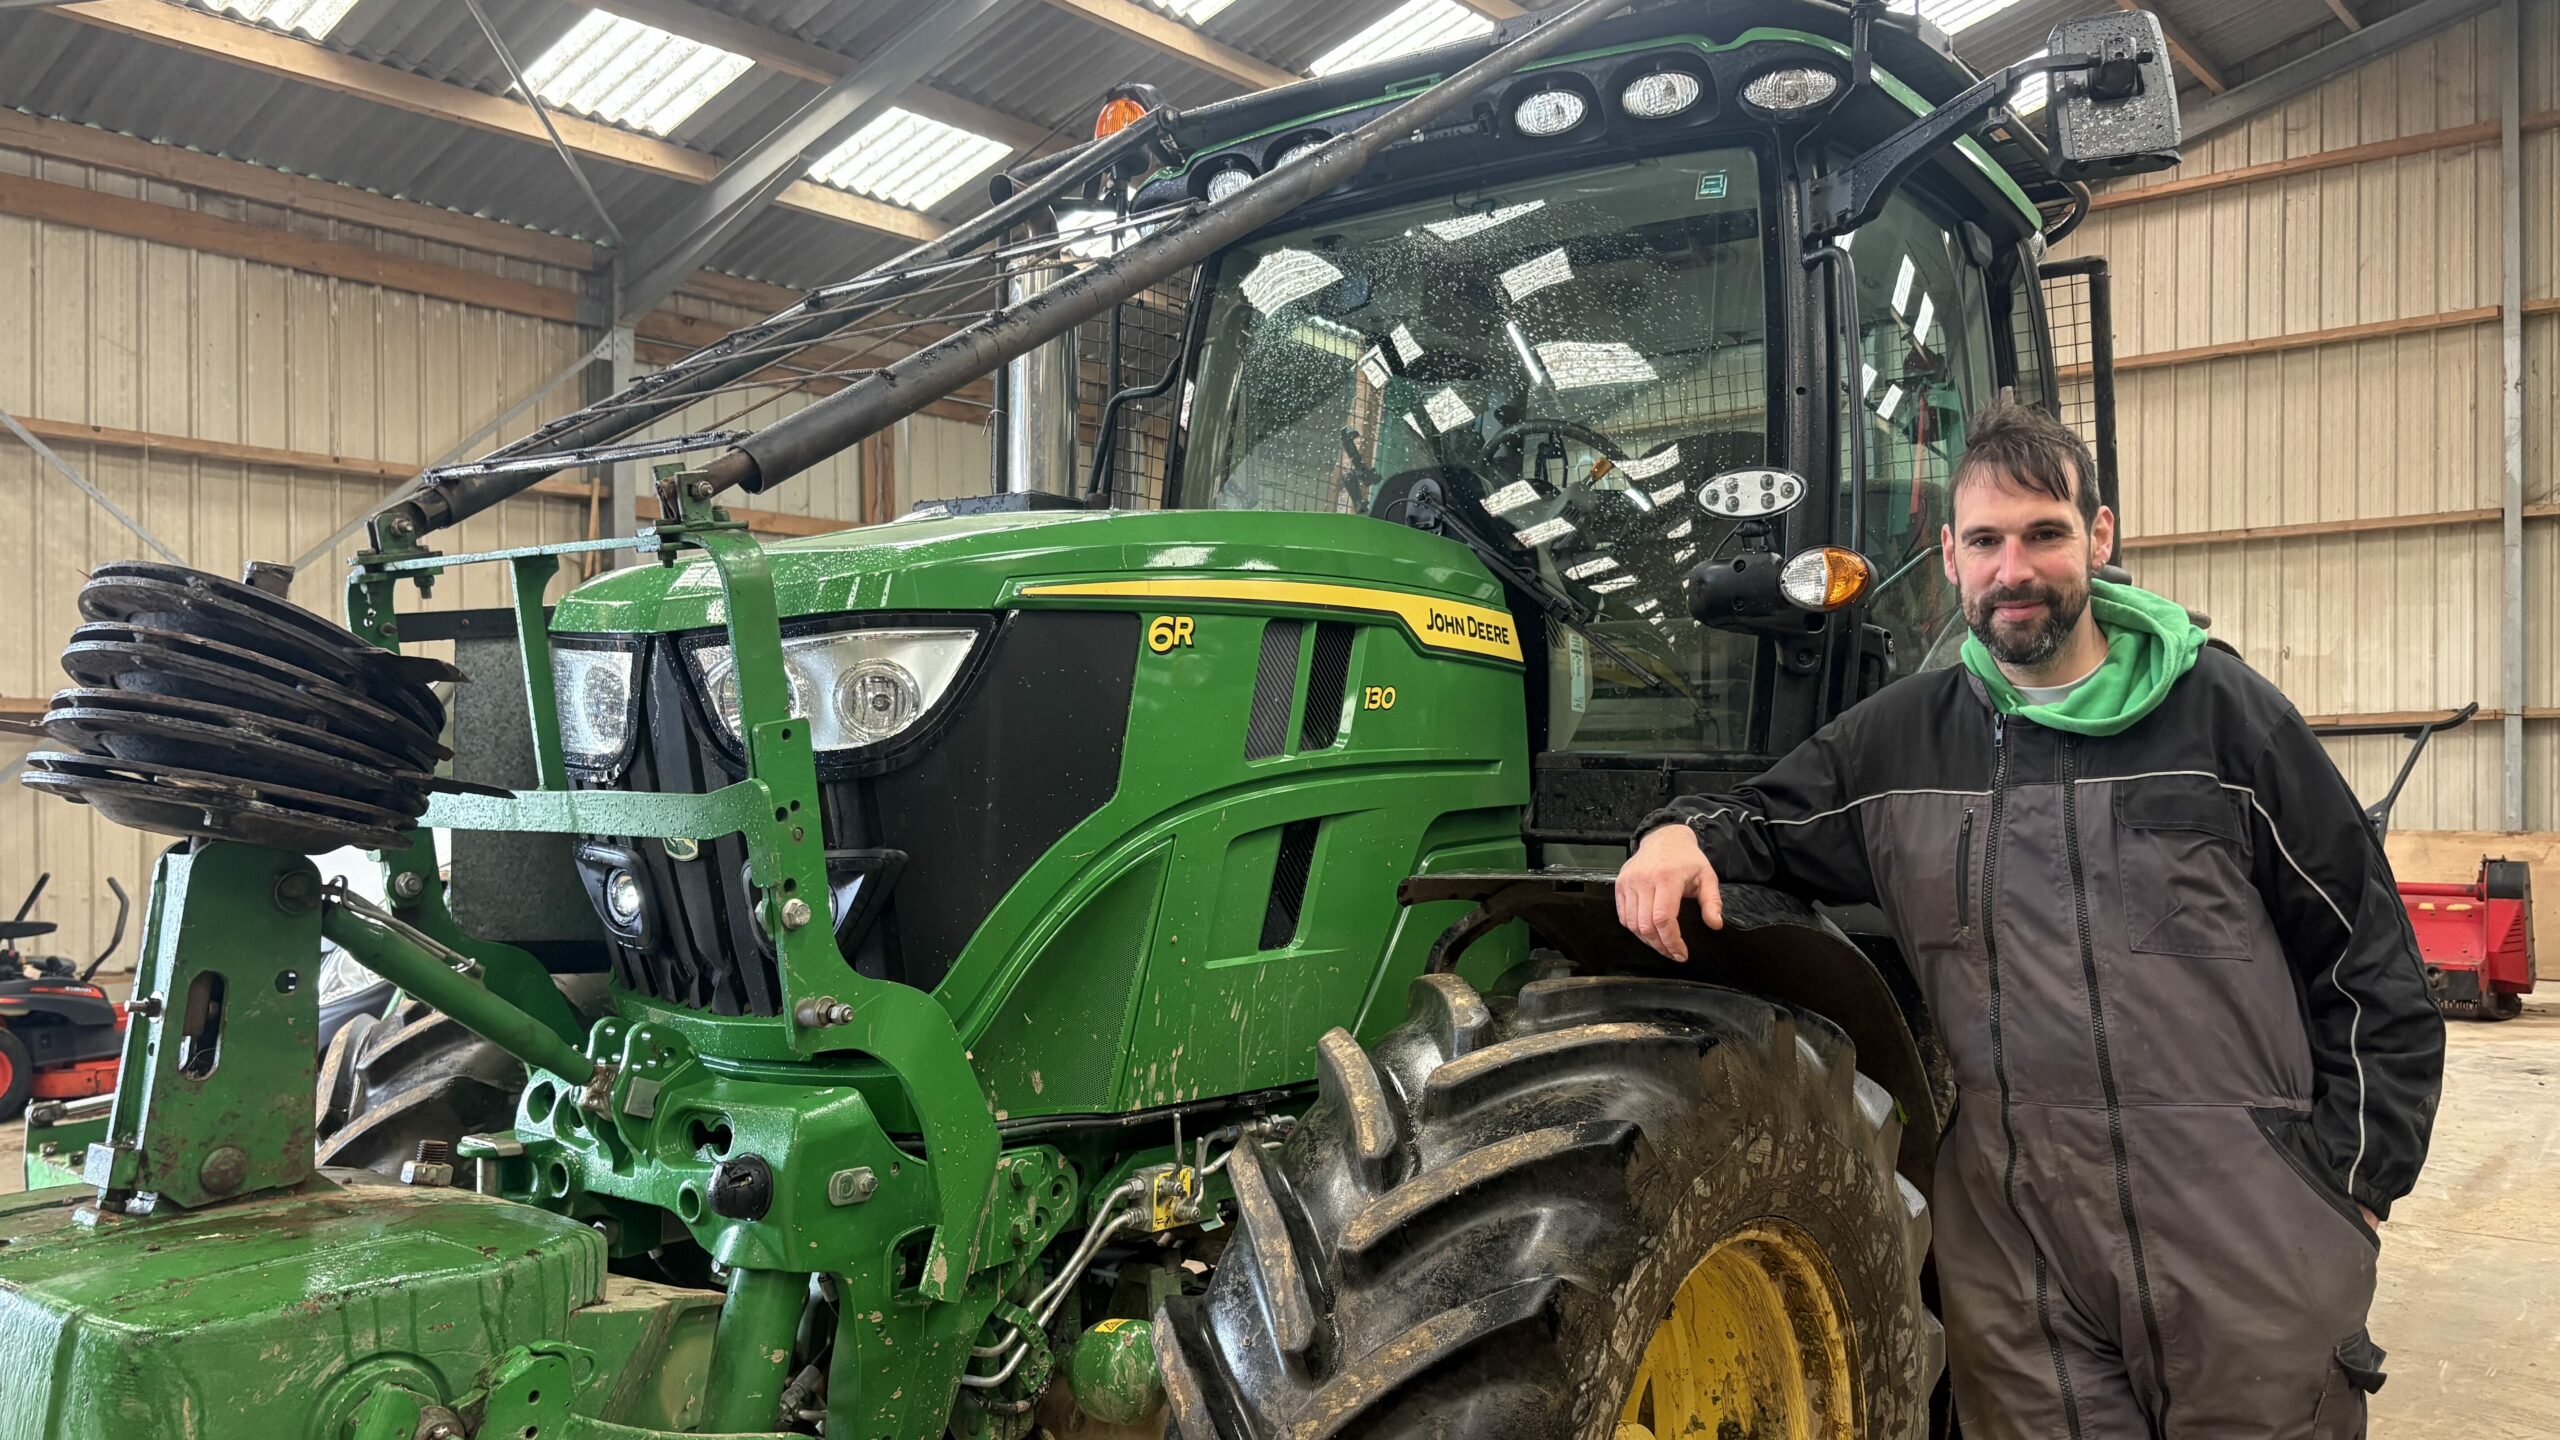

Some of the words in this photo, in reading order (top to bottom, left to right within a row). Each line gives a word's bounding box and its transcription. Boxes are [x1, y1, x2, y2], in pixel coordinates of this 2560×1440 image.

[1148, 615, 1195, 653] 6R
[1426, 607, 1466, 637] JOHN
[1466, 615, 1510, 646] DEERE
[1364, 686, 1397, 710] 130
